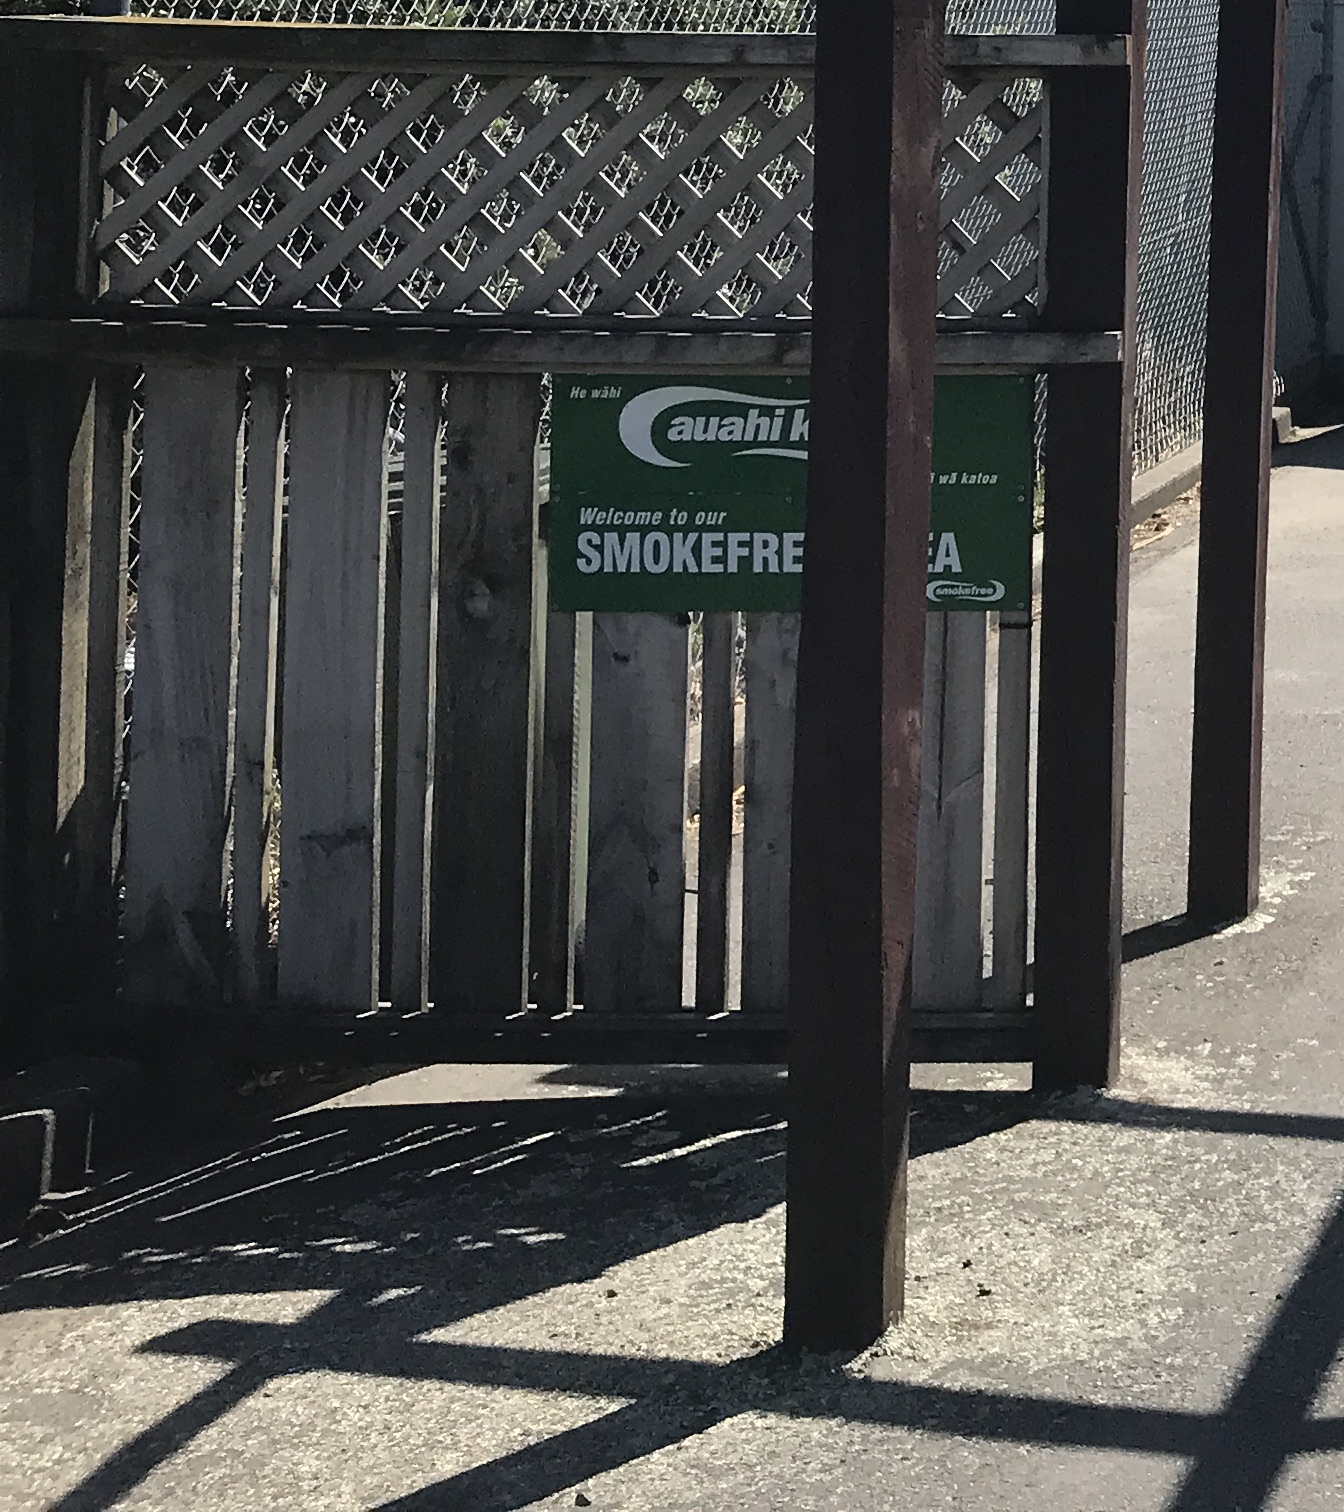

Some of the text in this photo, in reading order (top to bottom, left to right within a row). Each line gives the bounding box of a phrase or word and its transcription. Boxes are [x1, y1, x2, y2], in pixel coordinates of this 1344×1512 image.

[570, 386, 588, 399] He
[667, 408, 786, 442] auahi
[961, 472, 998, 484] katoa
[579, 507, 727, 525] Welcome to our
[576, 531, 805, 574] SMOKEFRE
[935, 585, 995, 595] smokefree
